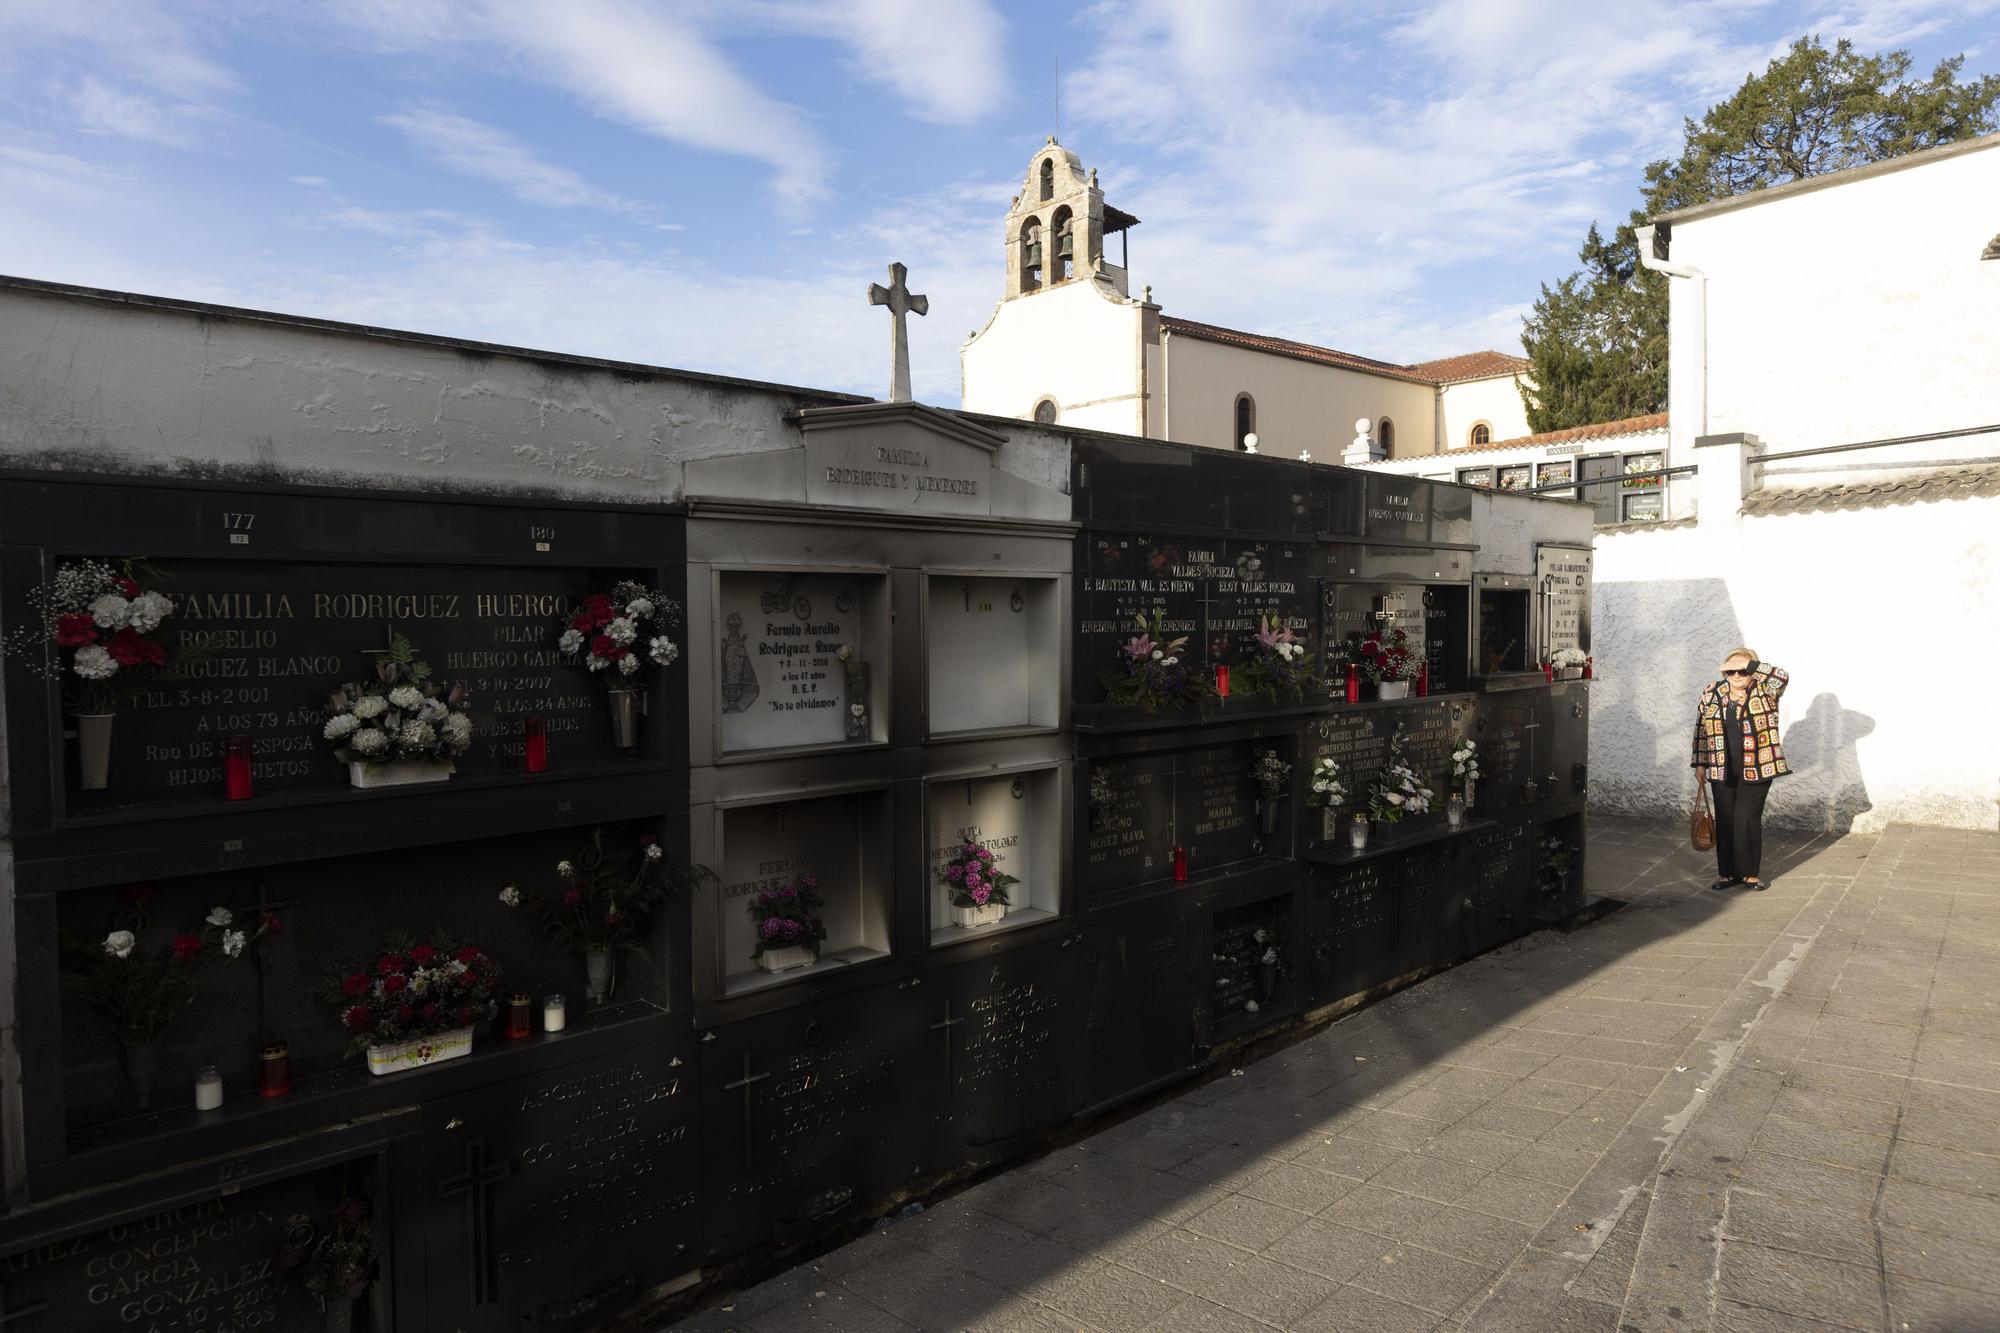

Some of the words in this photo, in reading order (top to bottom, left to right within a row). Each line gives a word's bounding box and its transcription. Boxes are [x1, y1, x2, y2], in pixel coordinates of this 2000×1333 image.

[826, 467, 897, 488] RODRIGUEZ
[223, 512, 256, 529] 177
[530, 526, 555, 540] 180
[1095, 578, 1137, 592] BAUTISTA
[1218, 580, 1239, 593] ELOY
[1241, 581, 1268, 593] VALDES
[313, 593, 460, 619] RODRIGUEZ
[475, 593, 569, 618] HUERGO
[494, 624, 545, 643] PILAR
[804, 622, 841, 636] Aurelio
[257, 655, 342, 678] BLANCO
[448, 650, 518, 670] HUERGO
[147, 691, 172, 709] EL
[786, 702, 794, 711] te
[197, 716, 210, 732] A
[217, 713, 252, 730] LOS
[256, 712, 279, 728] 79
[189, 741, 214, 758] DE
[168, 767, 223, 786] HIJOS
[1208, 806, 1233, 818] MARIA
[1121, 829, 1145, 843] NAVA
[86, 1207, 273, 1278] CONCEPCION
[88, 1256, 202, 1305] GARCIA
[120, 1259, 273, 1323] GONZALEZ
